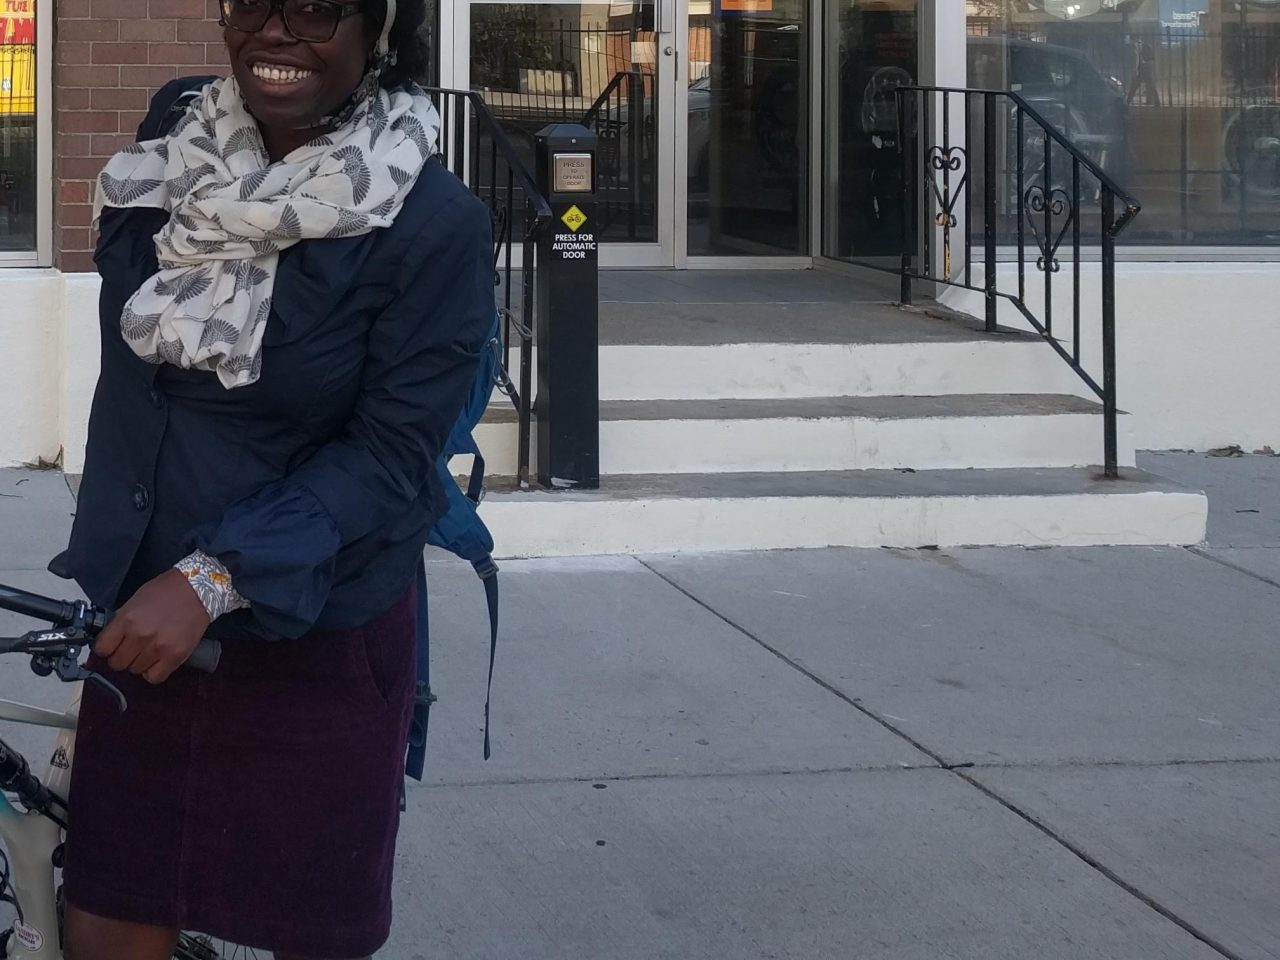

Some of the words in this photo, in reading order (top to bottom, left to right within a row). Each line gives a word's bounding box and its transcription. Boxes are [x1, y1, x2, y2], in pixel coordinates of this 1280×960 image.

[552, 242, 596, 250] AUTOMATIC
[563, 251, 586, 259] DOOR
[37, 631, 67, 641] SLX
